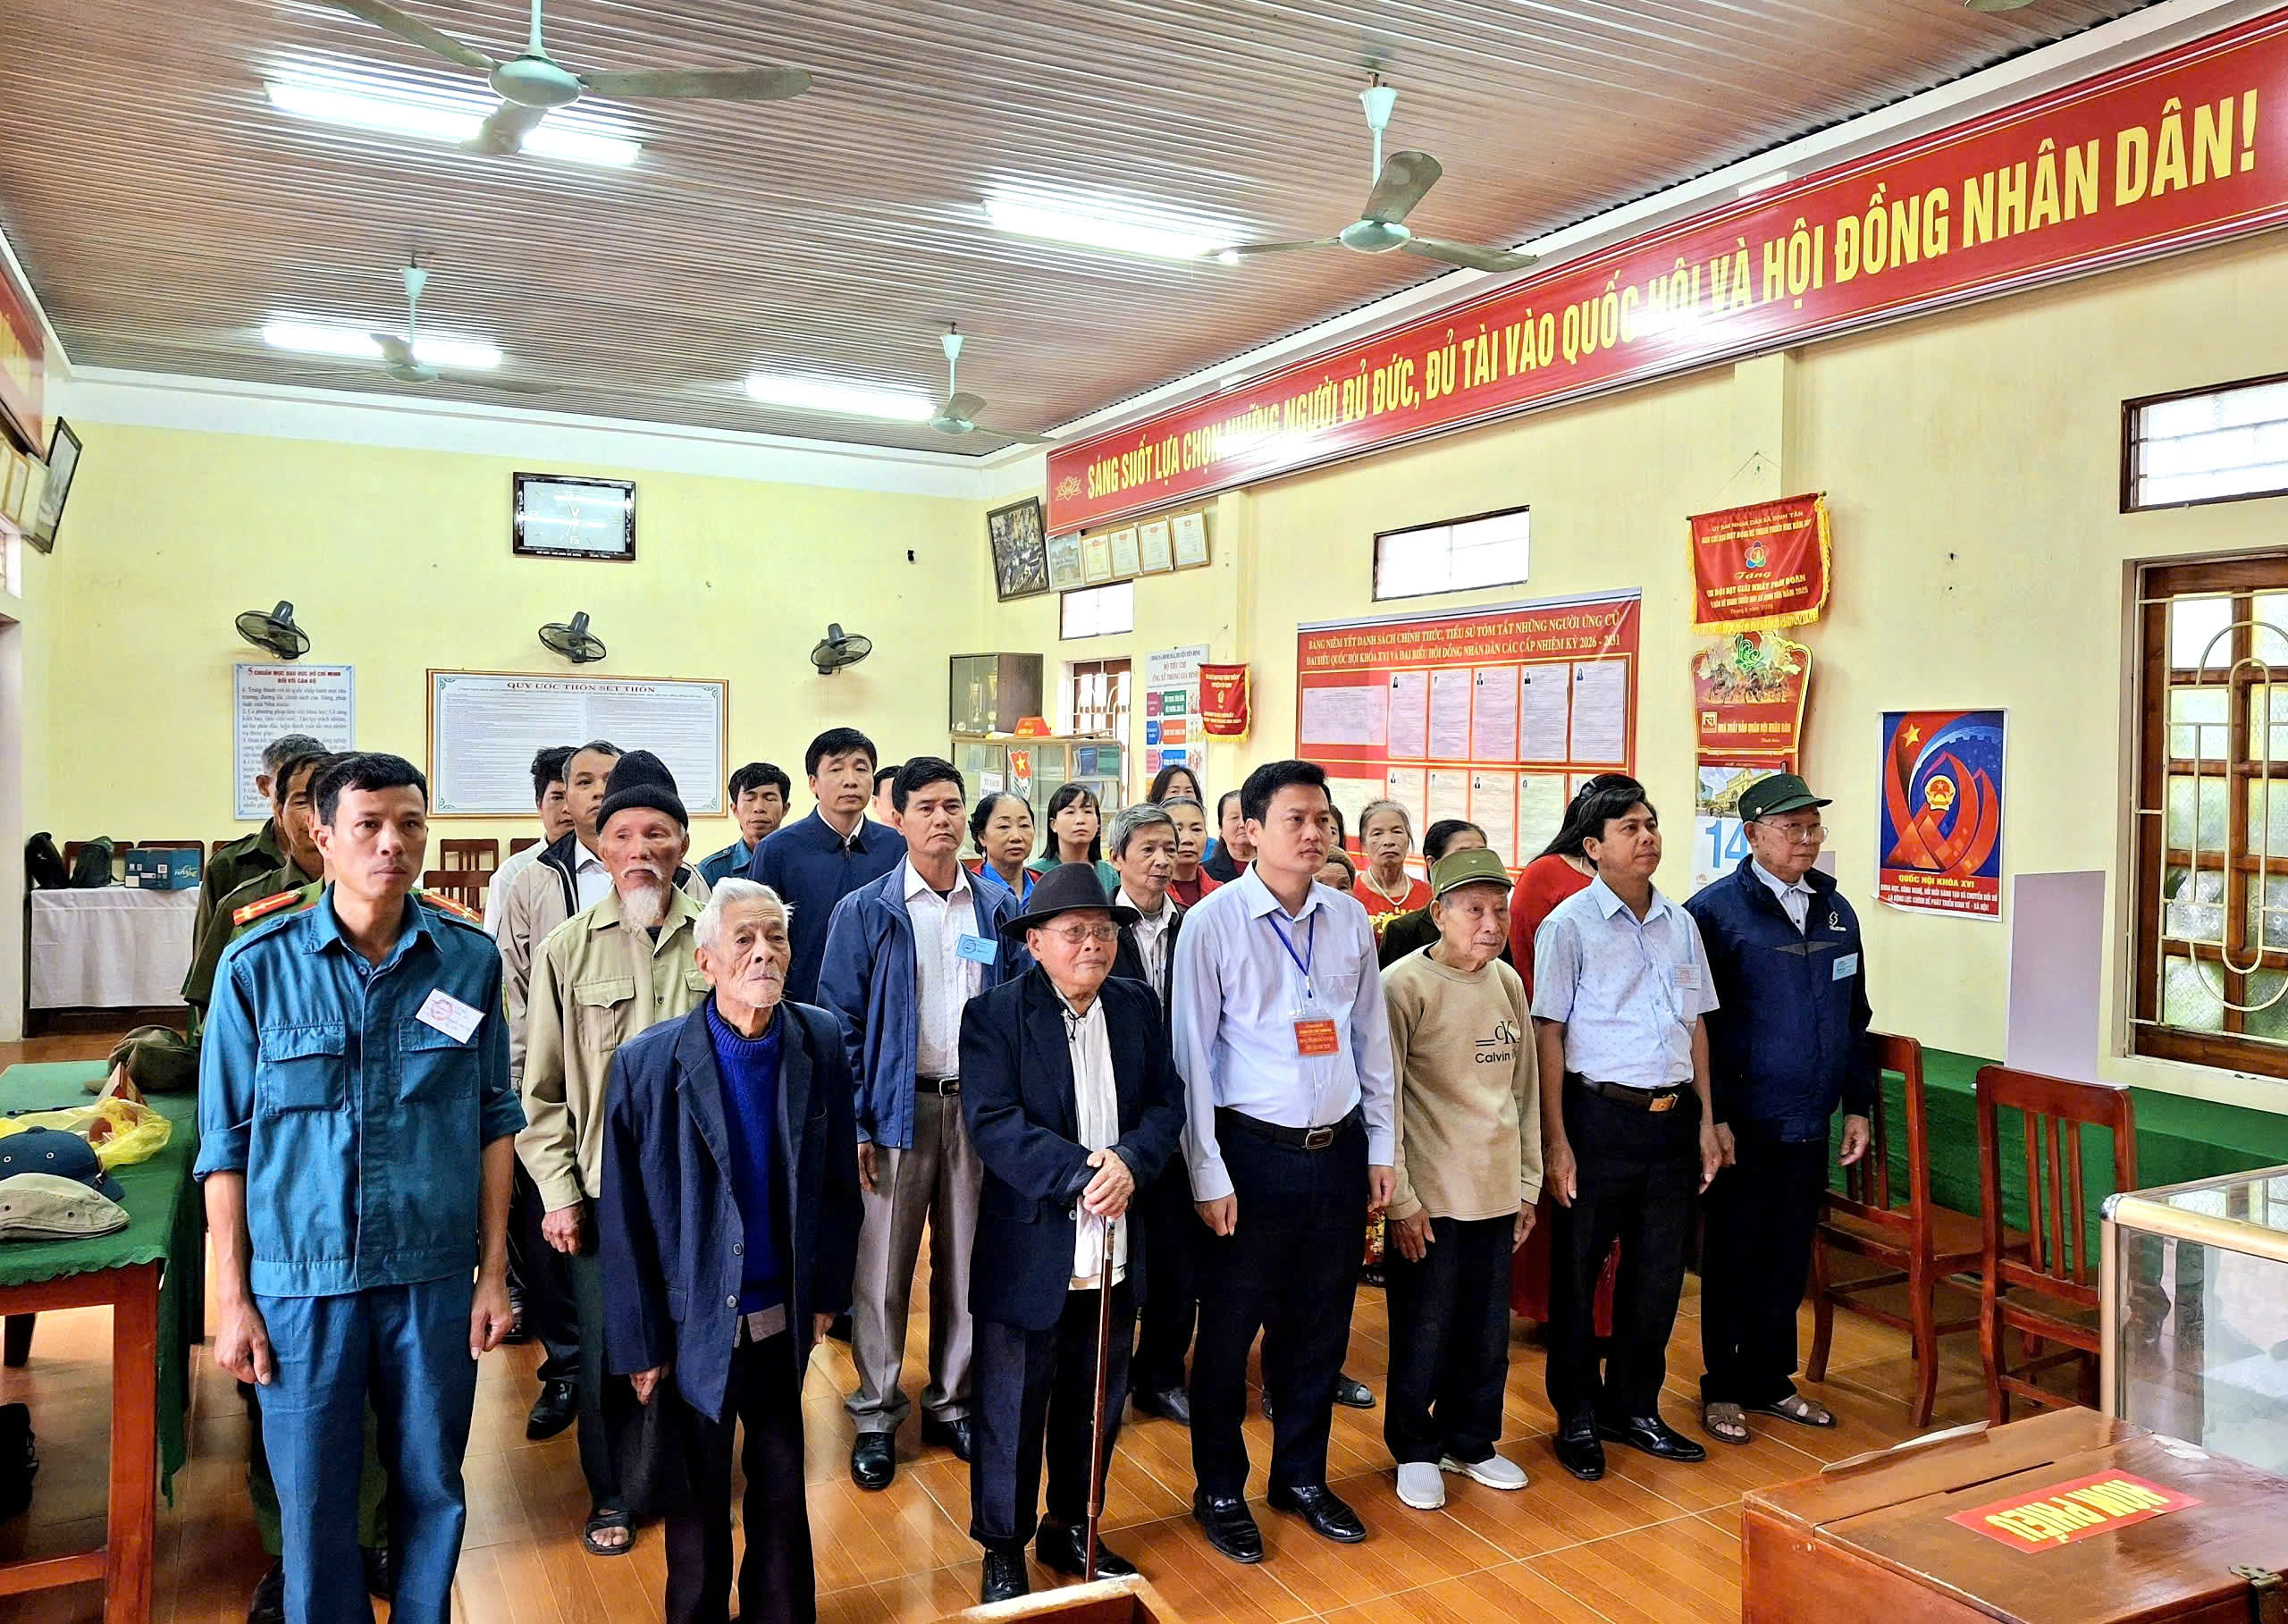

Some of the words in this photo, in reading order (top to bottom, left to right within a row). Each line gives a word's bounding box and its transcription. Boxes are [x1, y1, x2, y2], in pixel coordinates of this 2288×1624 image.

[1088, 455, 1118, 500] SÁNG
[1122, 434, 1153, 489] SUỐT
[1156, 434, 1180, 485] LỰA
[1183, 421, 1223, 475] CHỌN
[1284, 375, 1338, 434] NGƯỜI
[1342, 358, 1367, 423] ĐỦ
[1372, 353, 1419, 415] ĐỨC,
[1426, 328, 1456, 400] ĐỦ
[1463, 324, 1499, 389] TÀI
[1506, 308, 1555, 376] VÀO
[1562, 270, 1639, 366] QUỐC
[1710, 236, 1753, 314] VÀ
[1762, 216, 1824, 309] HỘI
[1835, 182, 1949, 283] ĐỒNG
[1963, 137, 2099, 248] NHÂN
[2116, 88, 2258, 207] DÂN!
[1308, 636, 1325, 650] BẢNG
[1326, 636, 1343, 648] NIÊM
[1343, 633, 1357, 647] YẾT
[1358, 635, 1376, 646] DANH
[1377, 631, 1395, 644] SÁCH
[1397, 629, 1420, 643] CHÍNH
[1422, 627, 1443, 641] THỨC,
[1446, 623, 1463, 639] TIỂU
[1465, 623, 1476, 637] SỬ
[1477, 623, 1495, 636] TÓM
[1497, 618, 1514, 635] TẮT
[1516, 618, 1546, 634] NHỮNG
[1549, 613, 1579, 630] NGƯỜI
[1582, 613, 1602, 627] ỨNG
[1605, 609, 1619, 627] CỬ
[1705, 820, 1752, 868] 14
[1899, 873, 1920, 883] QUỐC
[1922, 875, 1935, 885] HỘI
[1937, 877, 1958, 887] KHÓA
[1961, 879, 1974, 888] XVI
[1475, 1051, 1510, 1064] Calvin
[2065, 1479, 2171, 1518] HÒM
[1984, 1496, 2109, 1544] PHIẾU
